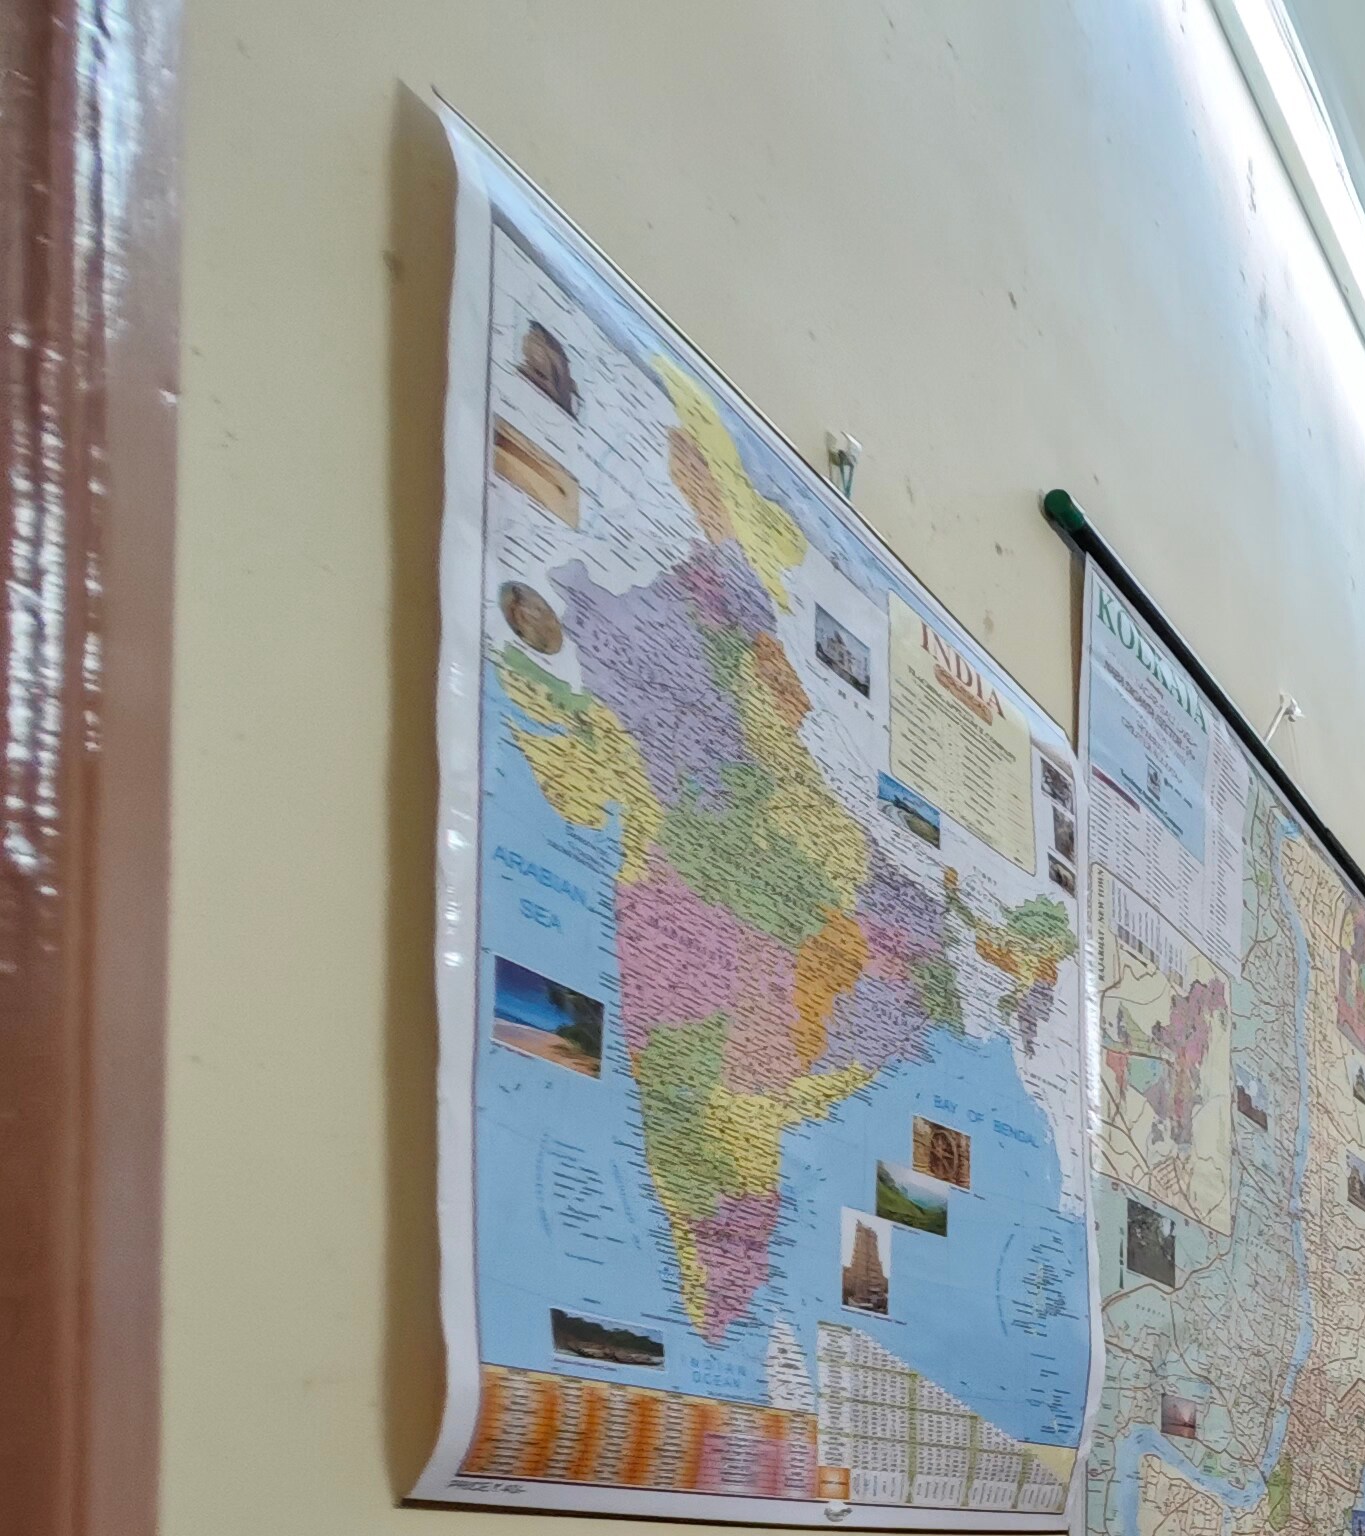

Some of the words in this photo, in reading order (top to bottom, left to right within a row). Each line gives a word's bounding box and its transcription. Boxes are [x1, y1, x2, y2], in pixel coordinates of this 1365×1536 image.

[920, 619, 1007, 721] INDIA
[1096, 585, 1208, 736] KOLKATA
[493, 846, 588, 907] ARABIAN
[520, 898, 564, 934] SEA
[933, 1094, 958, 1114] BAY
[967, 1109, 985, 1123] OF
